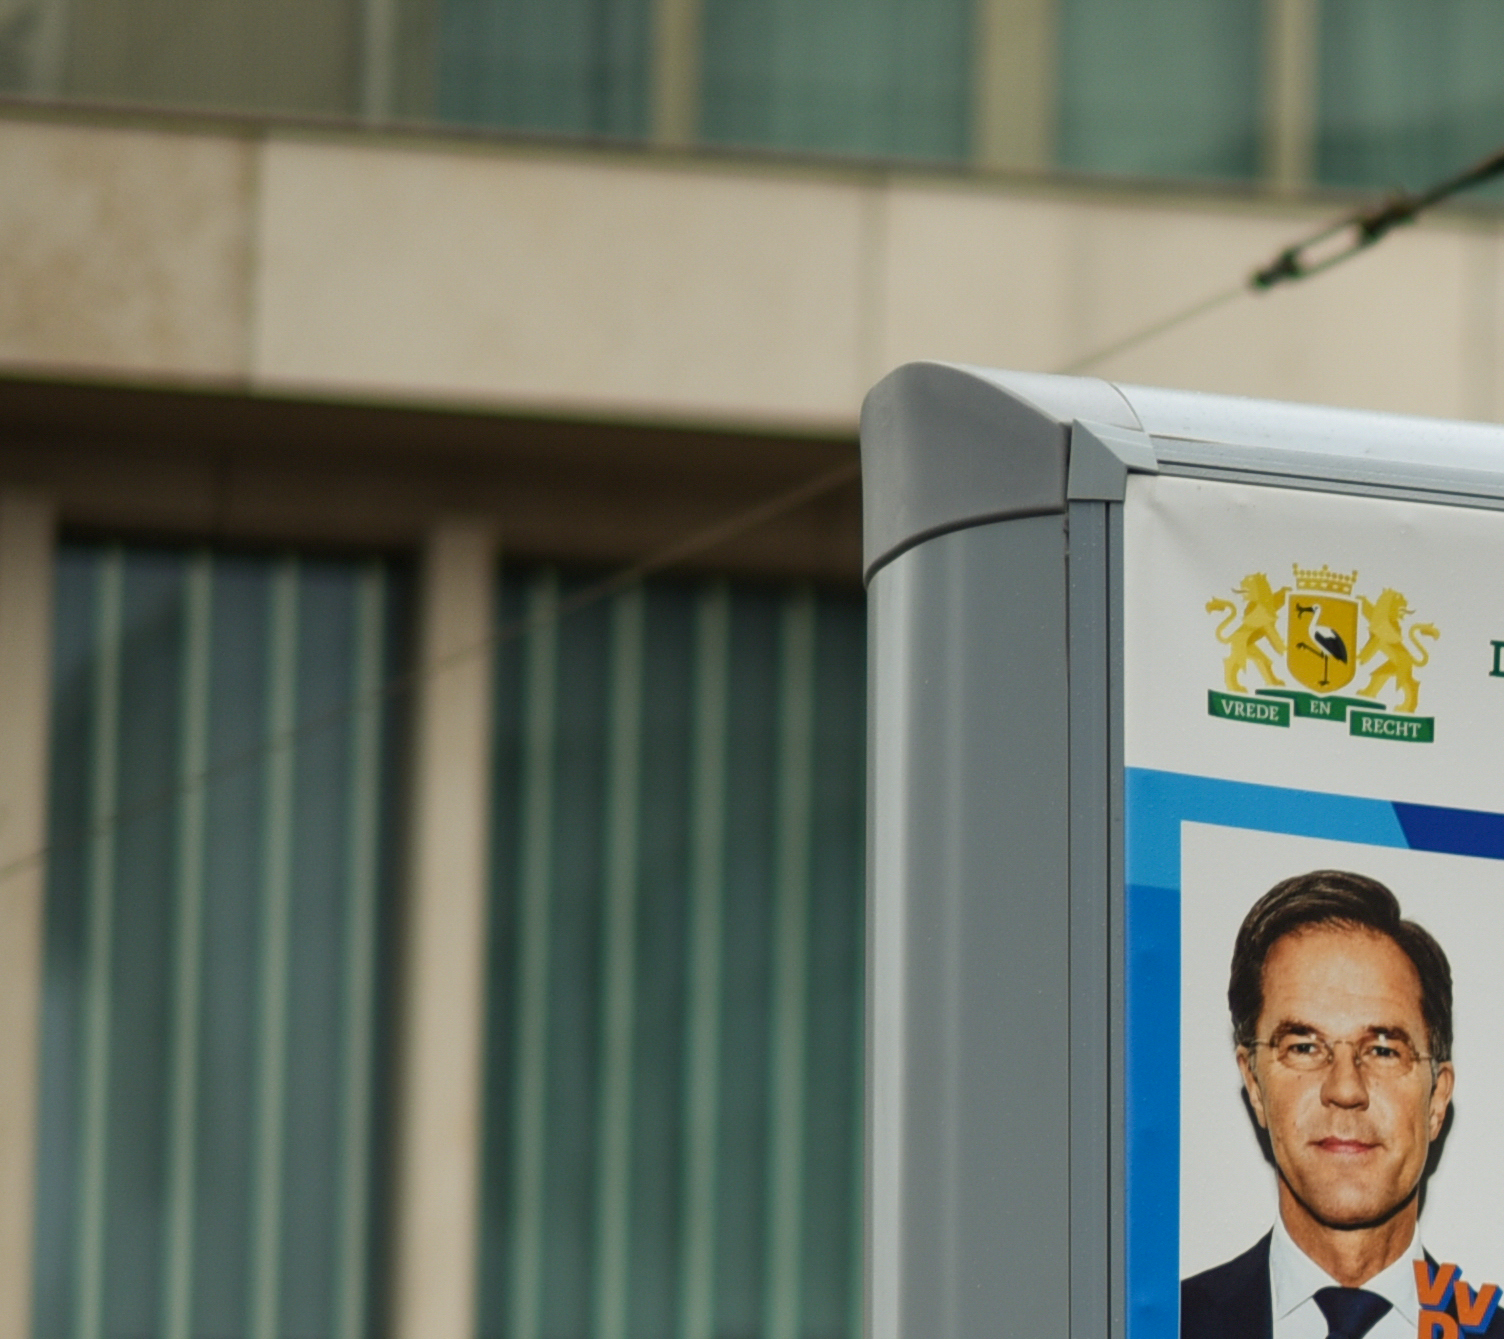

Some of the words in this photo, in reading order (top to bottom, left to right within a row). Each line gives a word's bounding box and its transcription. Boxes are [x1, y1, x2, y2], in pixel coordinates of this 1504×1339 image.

[1221, 699, 1279, 721] VREDE
[1310, 701, 1331, 715] EN
[1362, 717, 1421, 738] RECHT
